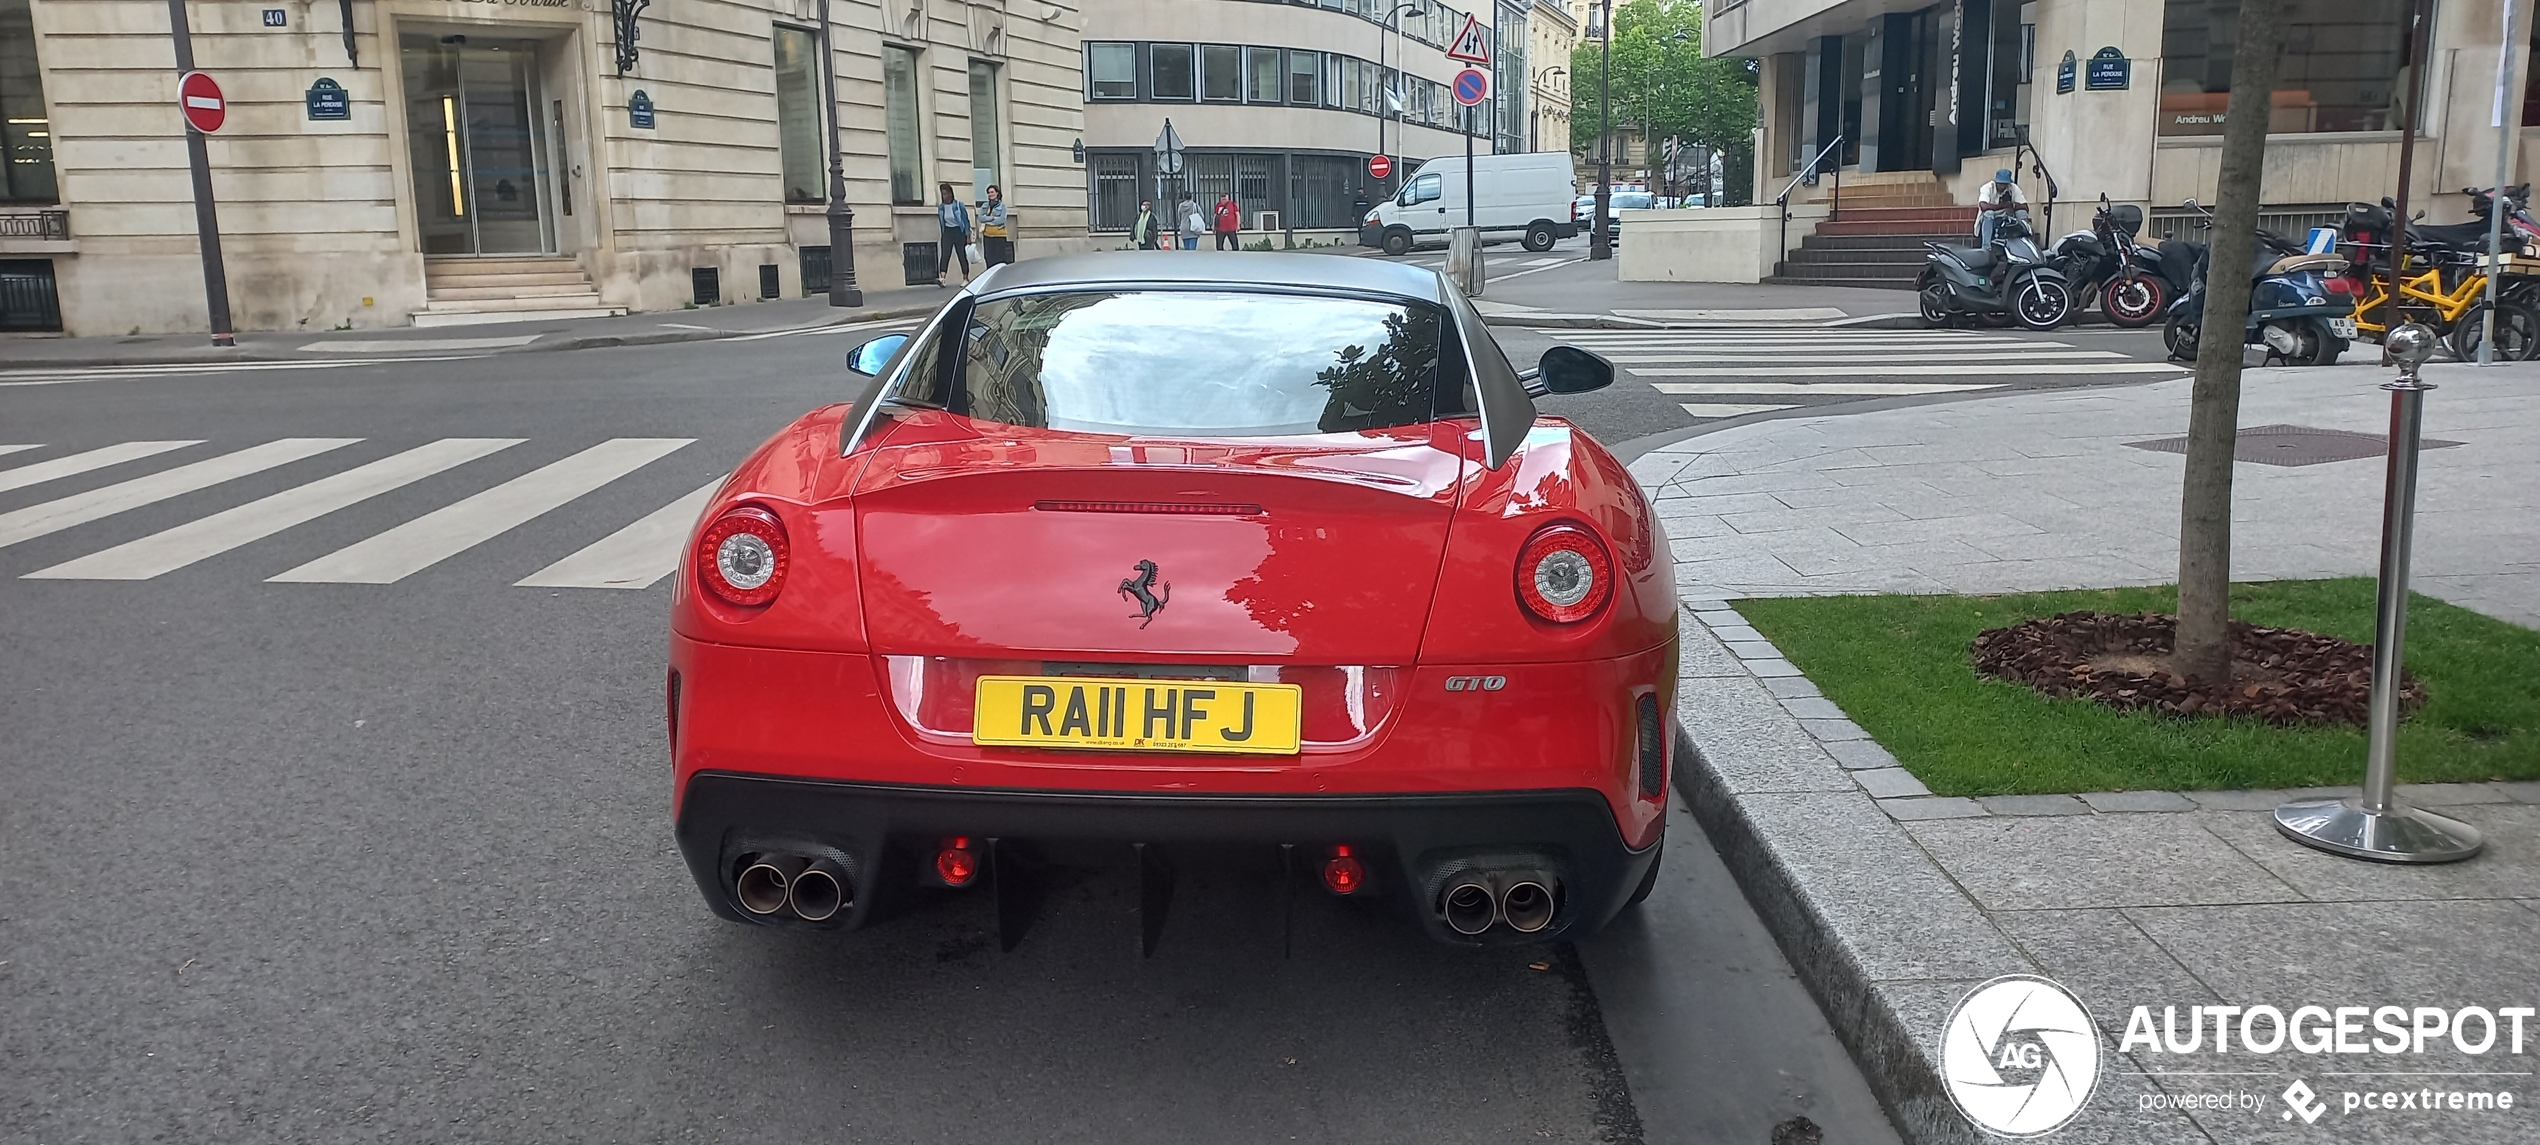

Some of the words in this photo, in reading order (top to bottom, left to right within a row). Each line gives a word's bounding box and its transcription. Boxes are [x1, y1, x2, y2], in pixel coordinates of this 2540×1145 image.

[265, 11, 283, 25] 40
[1949, 54, 1959, 125] Andreu
[2175, 115, 2210, 124] Andreu
[1444, 675, 1507, 691] GTO
